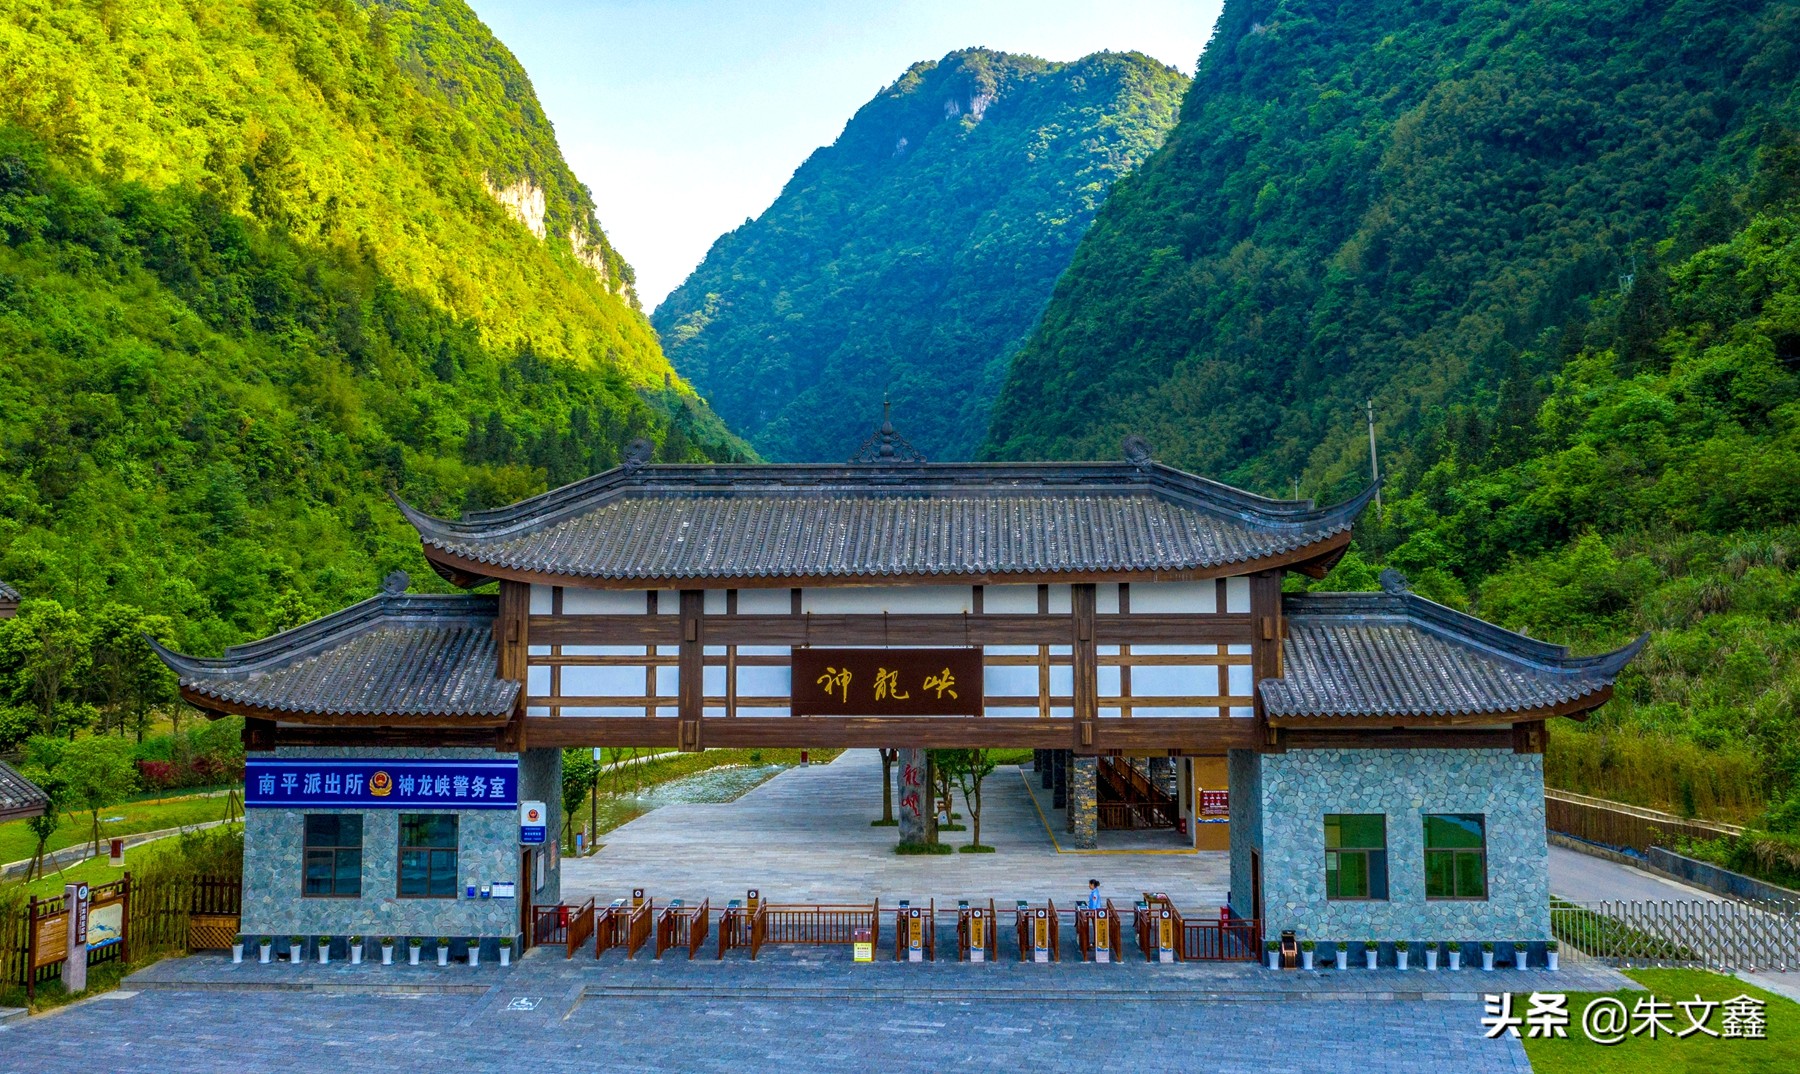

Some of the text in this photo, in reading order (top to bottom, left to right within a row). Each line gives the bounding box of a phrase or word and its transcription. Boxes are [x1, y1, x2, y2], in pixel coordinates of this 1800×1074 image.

[258, 773, 506, 798] 南平派出所 神龙峡警务室
